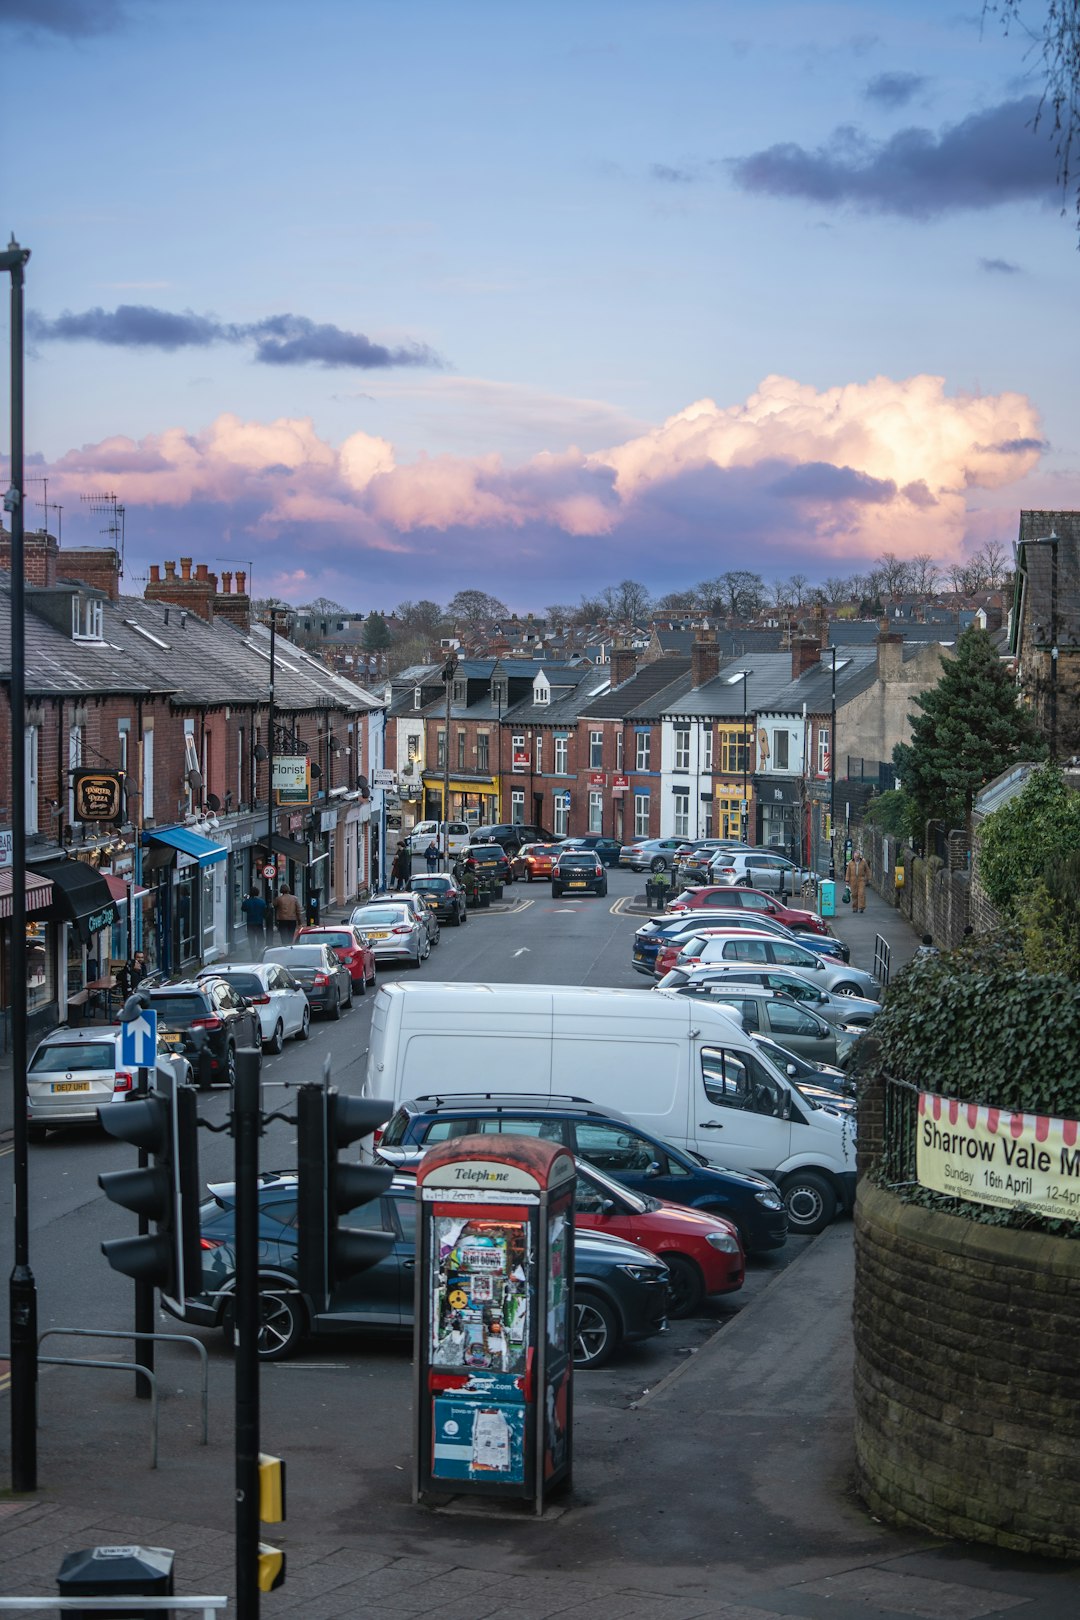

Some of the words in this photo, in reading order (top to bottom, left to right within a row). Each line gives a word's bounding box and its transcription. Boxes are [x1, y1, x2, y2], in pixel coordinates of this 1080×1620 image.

[272, 764, 304, 774] Florist
[88, 794, 108, 802] PIZZA
[924, 1120, 995, 1161] Sharrow
[1002, 1137, 1051, 1171] Vale
[944, 1164, 974, 1186] Sunday
[984, 1169, 1003, 1189] 16th
[1005, 1174, 1032, 1196] April
